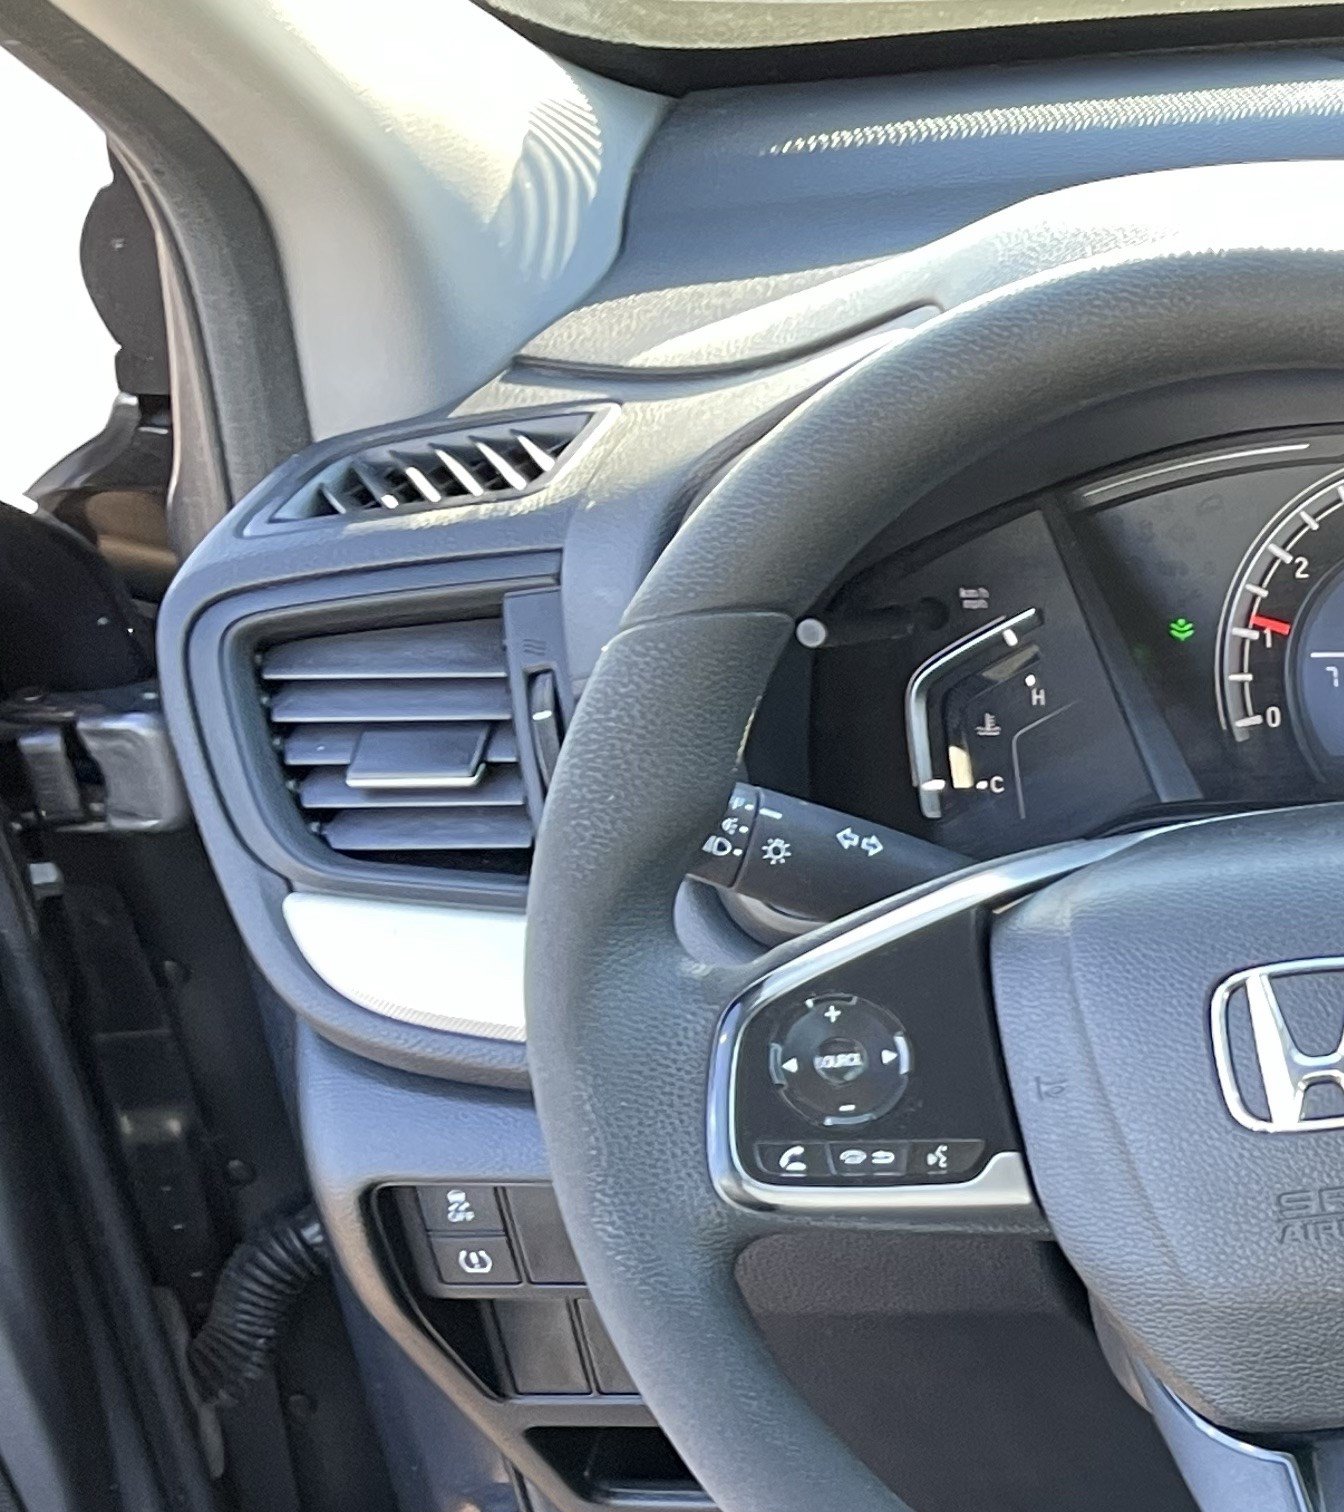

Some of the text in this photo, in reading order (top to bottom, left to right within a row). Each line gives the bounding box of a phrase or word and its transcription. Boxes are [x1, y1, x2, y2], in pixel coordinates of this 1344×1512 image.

[1294, 557, 1310, 579] 2
[1032, 689, 1046, 706] H
[1265, 706, 1281, 727] 0
[990, 775, 1005, 793] C
